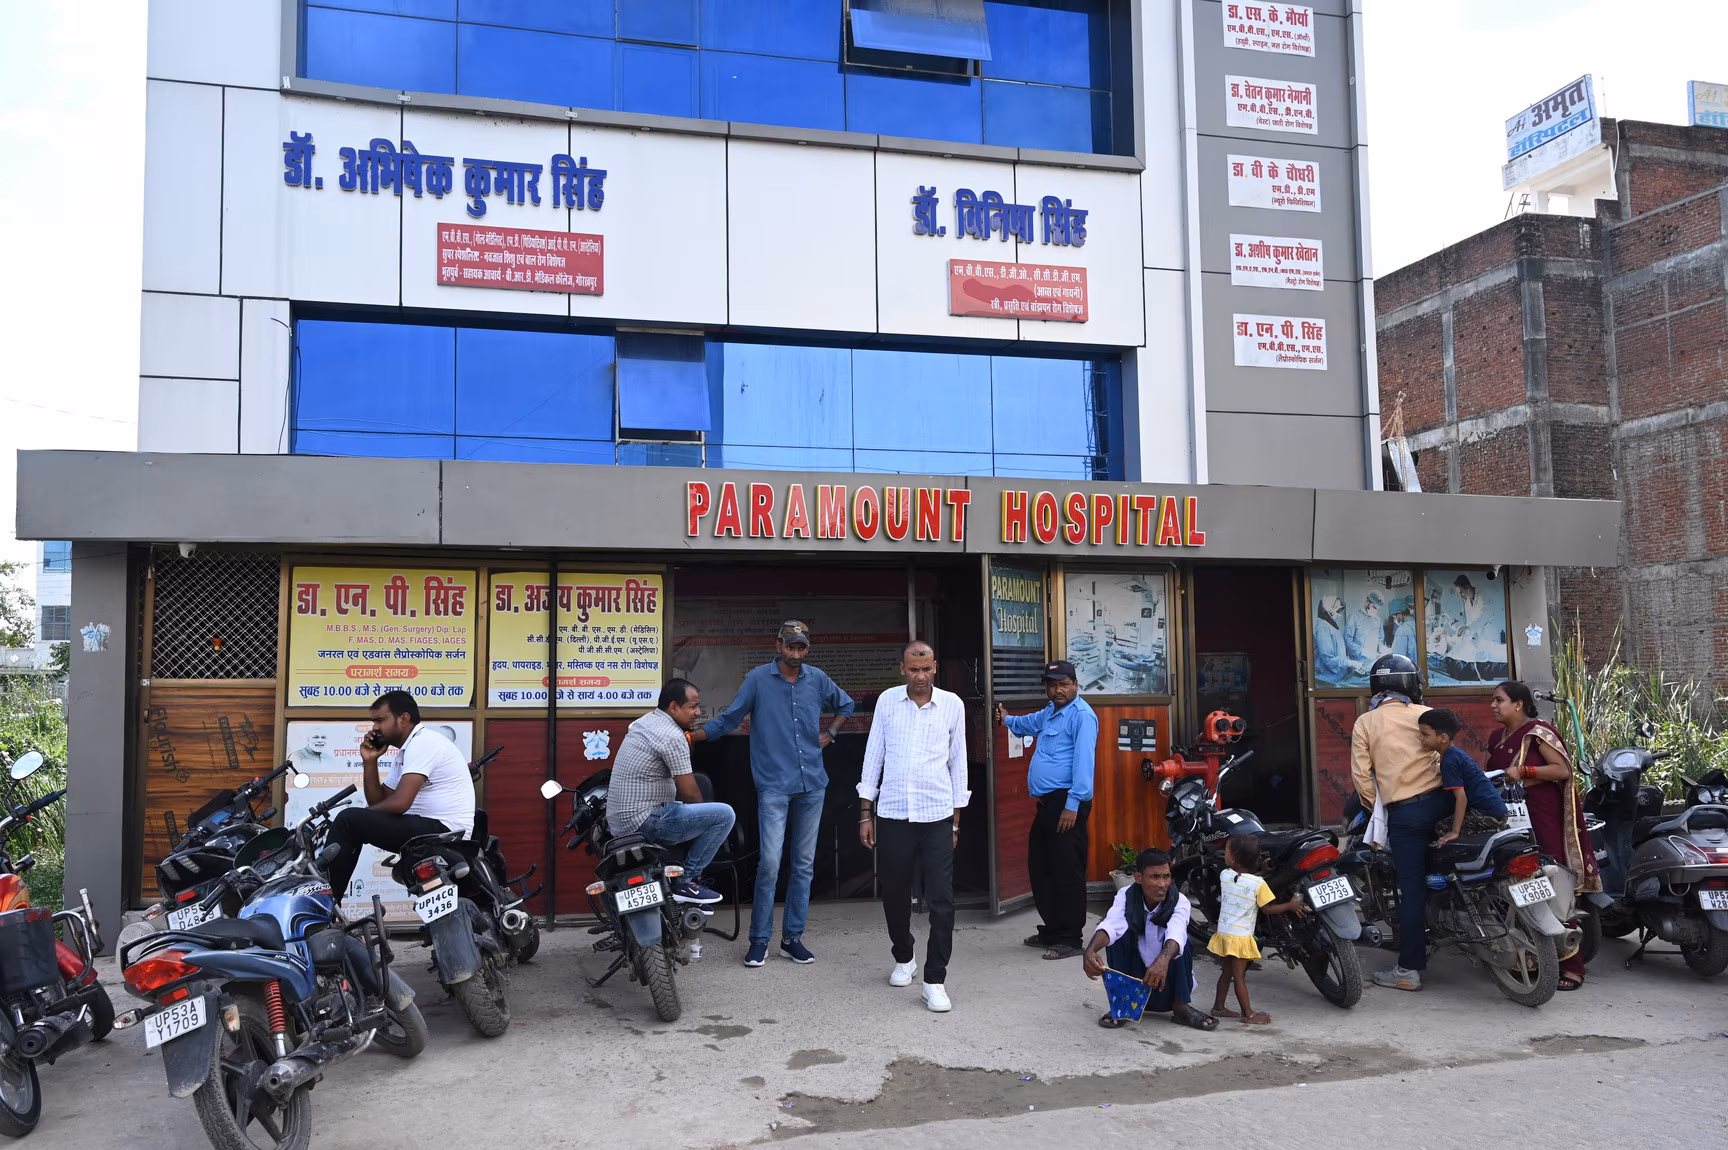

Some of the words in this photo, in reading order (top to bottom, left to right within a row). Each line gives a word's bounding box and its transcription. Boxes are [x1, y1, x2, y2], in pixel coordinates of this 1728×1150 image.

[1228, 4, 1243, 20] डा.
[1245, 6, 1266, 22] एस.
[1268, 5, 1283, 25] के.
[1285, 7, 1308, 27] मौर्या
[1231, 83, 1243, 99] डा.
[1244, 80, 1263, 100] चेतन
[1264, 86, 1286, 106] कुमार
[1287, 85, 1311, 105] नेमानी
[1531, 79, 1585, 127] अमृत
[1285, 118, 1295, 128] रोग
[283, 130, 323, 189] डॉ.
[338, 138, 455, 199] अभिषेक
[462, 156, 543, 218] कुमार
[551, 153, 607, 212] सिंह
[1267, 161, 1279, 179] के
[1286, 163, 1315, 183] चौधरी
[911, 185, 946, 237] डॉ.
[1040, 195, 1089, 247] सिंह
[1235, 242, 1246, 258] डा.
[1272, 244, 1294, 265] कुमार
[1295, 242, 1318, 262] खेतान
[1236, 321, 1253, 337] डा.
[1256, 322, 1278, 339] एन.
[1281, 320, 1298, 340] पी.
[1301, 321, 1323, 340] सिंह
[686, 480, 972, 542] PARAMOUNT
[1001, 488, 1206, 547] HOSPITAL
[296, 583, 327, 617] डा.
[334, 583, 377, 617] एन.
[384, 575, 417, 618] पी.
[424, 575, 467, 617] सिंह
[991, 575, 1041, 604] PARAMOUNT
[495, 584, 519, 613] डा.
[576, 586, 622, 623] कुमार
[625, 578, 658, 614] सिंह
[380, 625, 401, 634] (Gen.
[402, 625, 435, 635] Surgery)
[436, 626, 450, 634] Dip.
[452, 626, 466, 635] Lap
[630, 625, 658, 634] (मेडिसिन)
[997, 607, 1039, 642] Hospital
[442, 637, 466, 645] IAGES
[318, 649, 344, 659] जनरल
[347, 648, 360, 659] एवं
[362, 648, 391, 660] एडवांस
[393, 648, 443, 660] लैप्रोस्कोपिक
[445, 648, 466, 660] सर्जन
[350, 666, 382, 677] परामर्श
[384, 668, 409, 677] समय
[492, 661, 510, 671] हृदय,
[567, 659, 593, 670] मस्तिष्क
[595, 659, 605, 671] एवं
[607, 661, 618, 670] नस
[620, 659, 632, 670] रोग
[633, 659, 658, 671] विशेषज्ञ
[299, 686, 320, 699] सुबह
[324, 686, 352, 696] 10.00
[354, 683, 370, 696] बजे
[372, 683, 381, 696] से
[430, 683, 446, 696] बजे
[448, 686, 464, 697] तक
[498, 691, 518, 701] सुबह
[521, 691, 548, 700] 10.00
[567, 689, 575, 700] से
[577, 690, 595, 700] सायं
[597, 691, 618, 700] 4.00
[621, 689, 635, 700] बजे
[637, 691, 652, 700] तक
[623, 884, 656, 900] UP53D
[1315, 879, 1345, 896] UP53C
[1320, 889, 1349, 904] D7739
[1518, 879, 1547, 894] UP53C
[419, 887, 454, 910] UP14CQ
[627, 893, 658, 909] A5798
[427, 900, 452, 919] 3436
[154, 1001, 197, 1028] UP53A
[157, 1013, 198, 1040] Y1709
